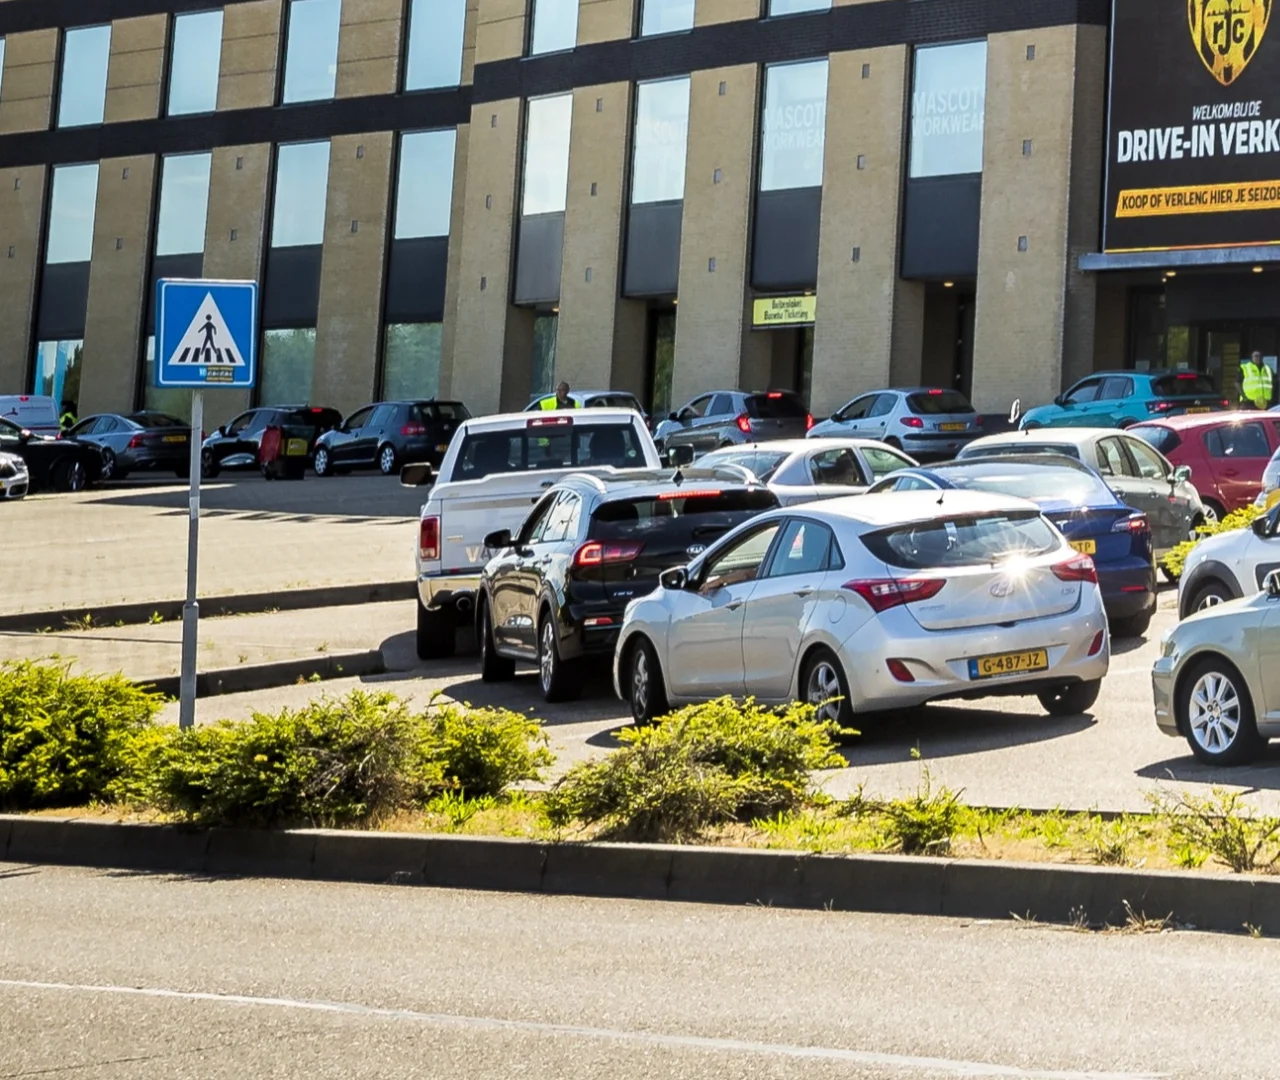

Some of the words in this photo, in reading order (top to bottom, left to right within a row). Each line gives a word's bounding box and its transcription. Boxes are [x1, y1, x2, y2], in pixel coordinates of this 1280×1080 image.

[1192, 104, 1233, 121] WELKOM
[1234, 102, 1248, 118] BIJ
[1248, 100, 1262, 117] DE
[1117, 123, 1215, 163] DRIVE-IN
[1122, 194, 1149, 210] KOOP
[1150, 195, 1163, 209] OF
[1164, 191, 1209, 207] VERLENG
[1210, 190, 1233, 204] HIER
[1234, 189, 1246, 203] JE
[983, 653, 1040, 672] G-487-JZ
